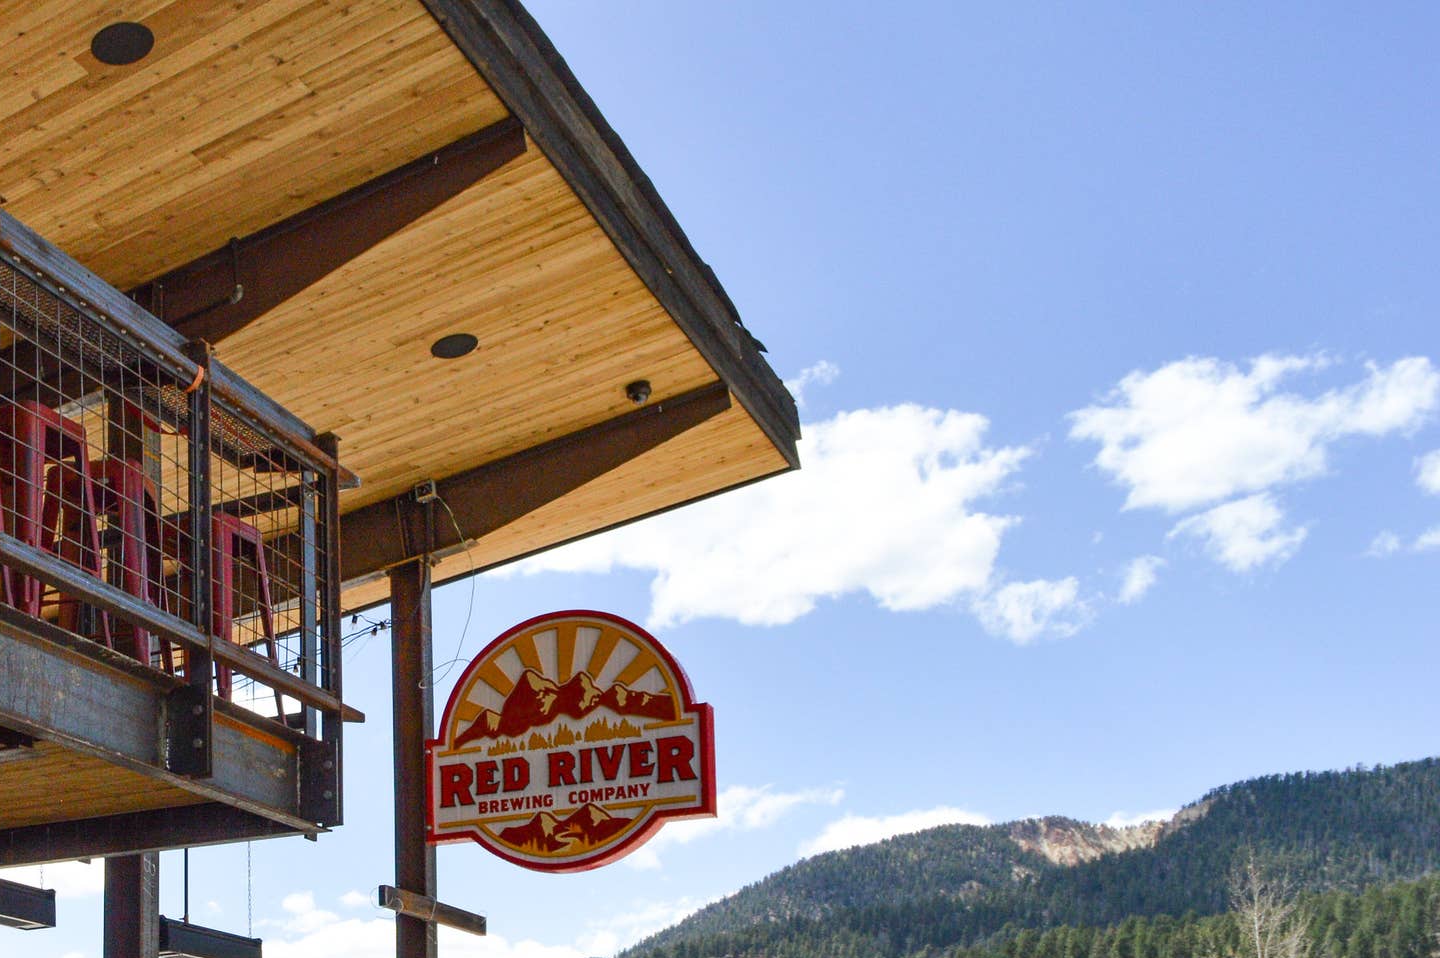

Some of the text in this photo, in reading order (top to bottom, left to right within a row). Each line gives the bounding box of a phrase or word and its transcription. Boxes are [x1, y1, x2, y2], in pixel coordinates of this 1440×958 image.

[439, 735, 698, 808] RED RIVER
[478, 783, 651, 815] BREWING COMPANY
